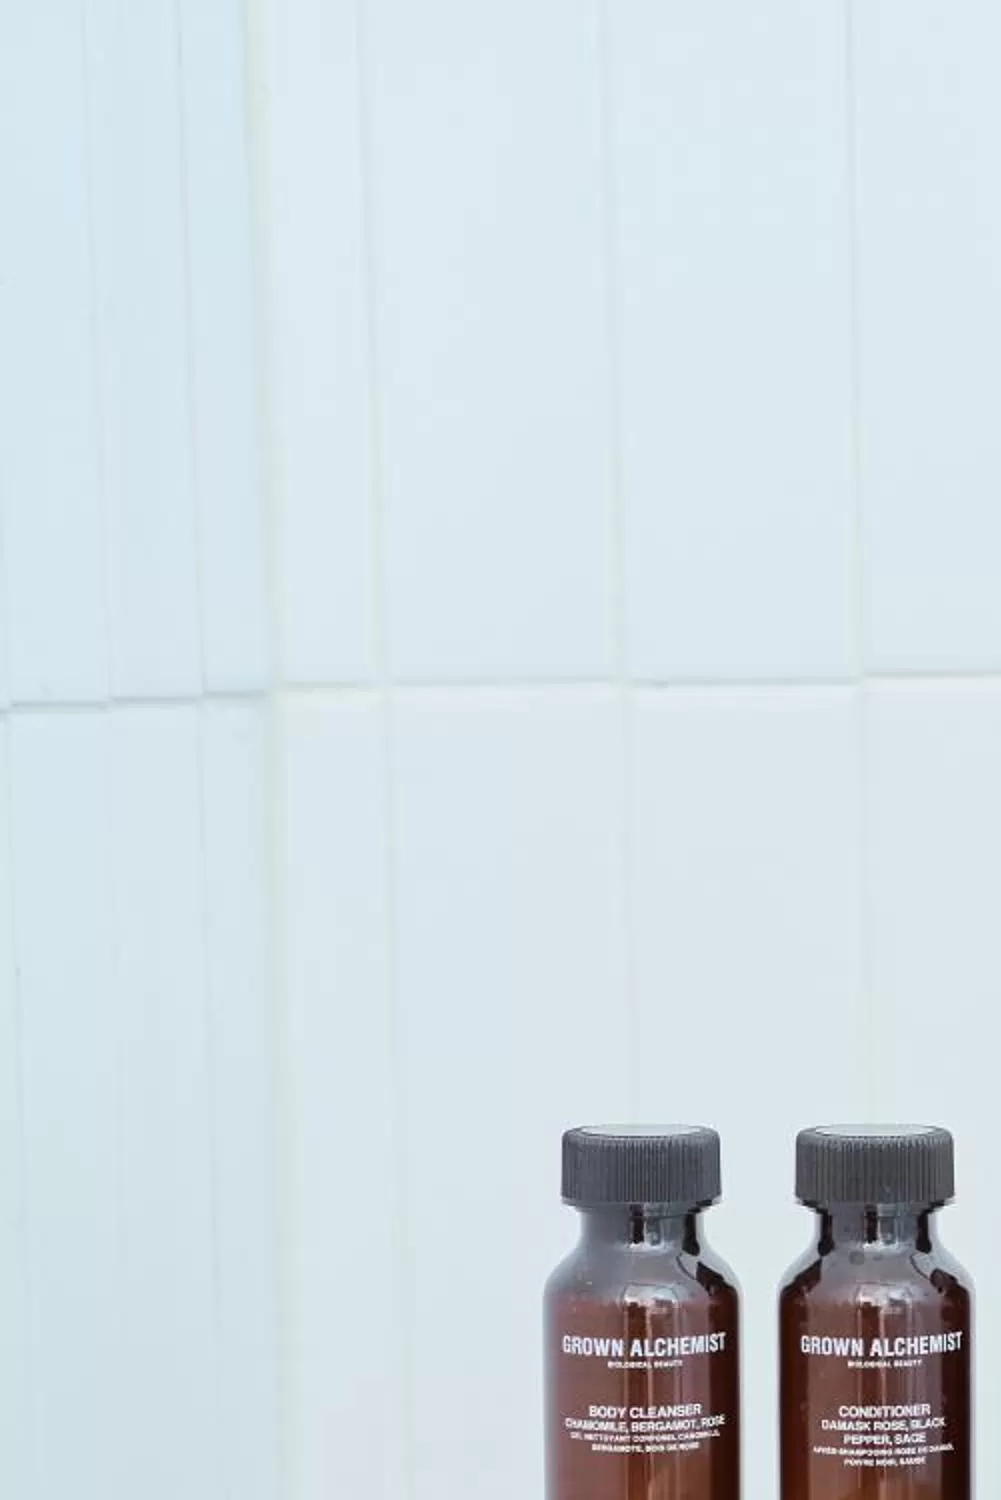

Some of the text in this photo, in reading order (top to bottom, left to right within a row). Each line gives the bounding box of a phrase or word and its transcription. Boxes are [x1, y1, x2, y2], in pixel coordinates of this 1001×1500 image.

[562, 1332, 726, 1357] GROWN ALCHEMIST
[801, 1332, 963, 1357] GROWN ALCHEMIST
[588, 1403, 702, 1419] BODY CLEANSER
[838, 1404, 931, 1418] CONDITIONER
[821, 1417, 946, 1432] DAMASK ROSE, BLACK
[843, 1432, 927, 1446] PEPPER, SAGE
